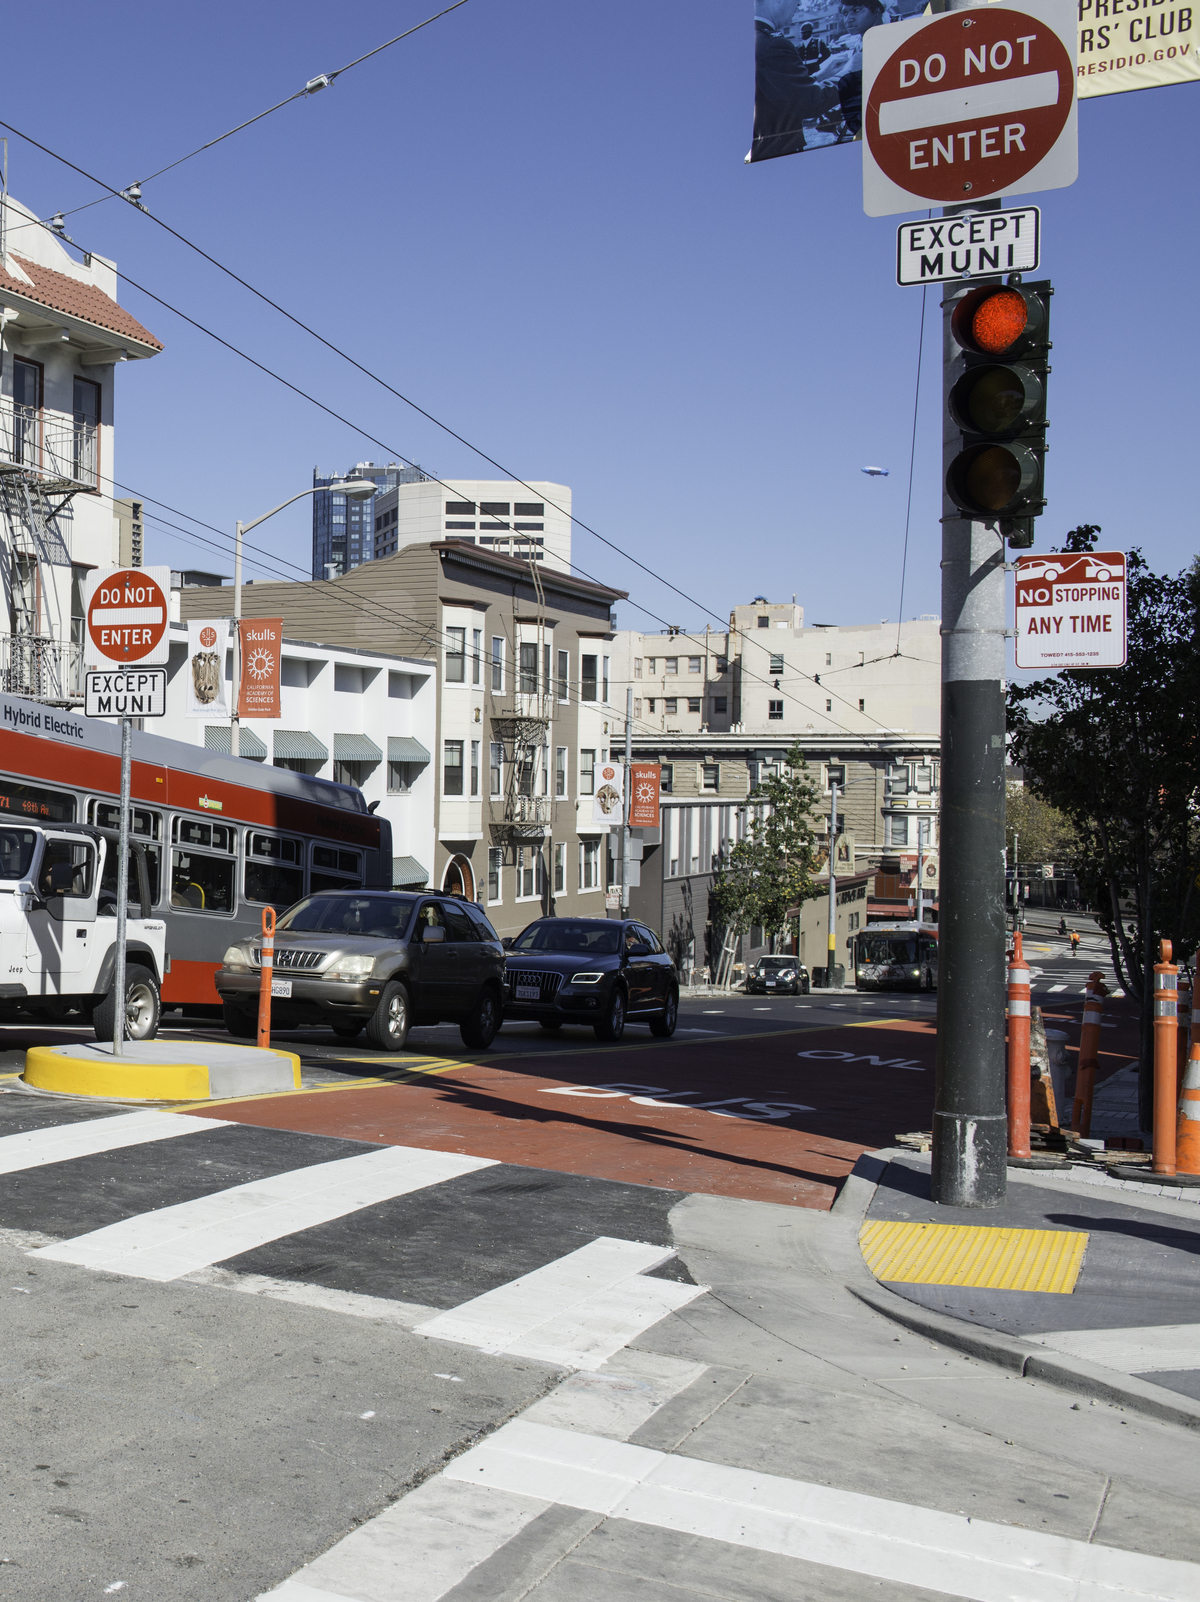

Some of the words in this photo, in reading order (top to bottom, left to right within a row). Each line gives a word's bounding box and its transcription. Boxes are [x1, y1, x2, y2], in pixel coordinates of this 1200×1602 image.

[1129, 7, 1192, 43] CLUB
[899, 53, 947, 89] DO
[964, 34, 1038, 76] NOT
[1077, 43, 1191, 77] RESIDIO.GOV
[909, 122, 1026, 170] ENTER
[910, 214, 1026, 252] EXCEPT
[920, 243, 1014, 278] MUNI
[100, 588, 121, 605] DO
[124, 586, 155, 604] NOT
[1019, 588, 1050, 604] NO
[1055, 586, 1120, 603] STOPPING
[246, 628, 276, 641] skulls
[1027, 616, 1064, 635] ANY
[1069, 614, 1112, 634] TIME
[101, 628, 152, 646] ENTER
[92, 674, 159, 693] EXCEPT
[97, 695, 152, 713] MUNI
[3, 704, 41, 729] Hybrid
[44, 715, 84, 740] Electric
[635, 770, 657, 779] skulls
[0, 795, 10, 808] 71
[22, 800, 39, 813] 48th
[8, 965, 24, 973] Jeep
[797, 1049, 927, 1071] ONL
[536, 1083, 818, 1119] BUS
